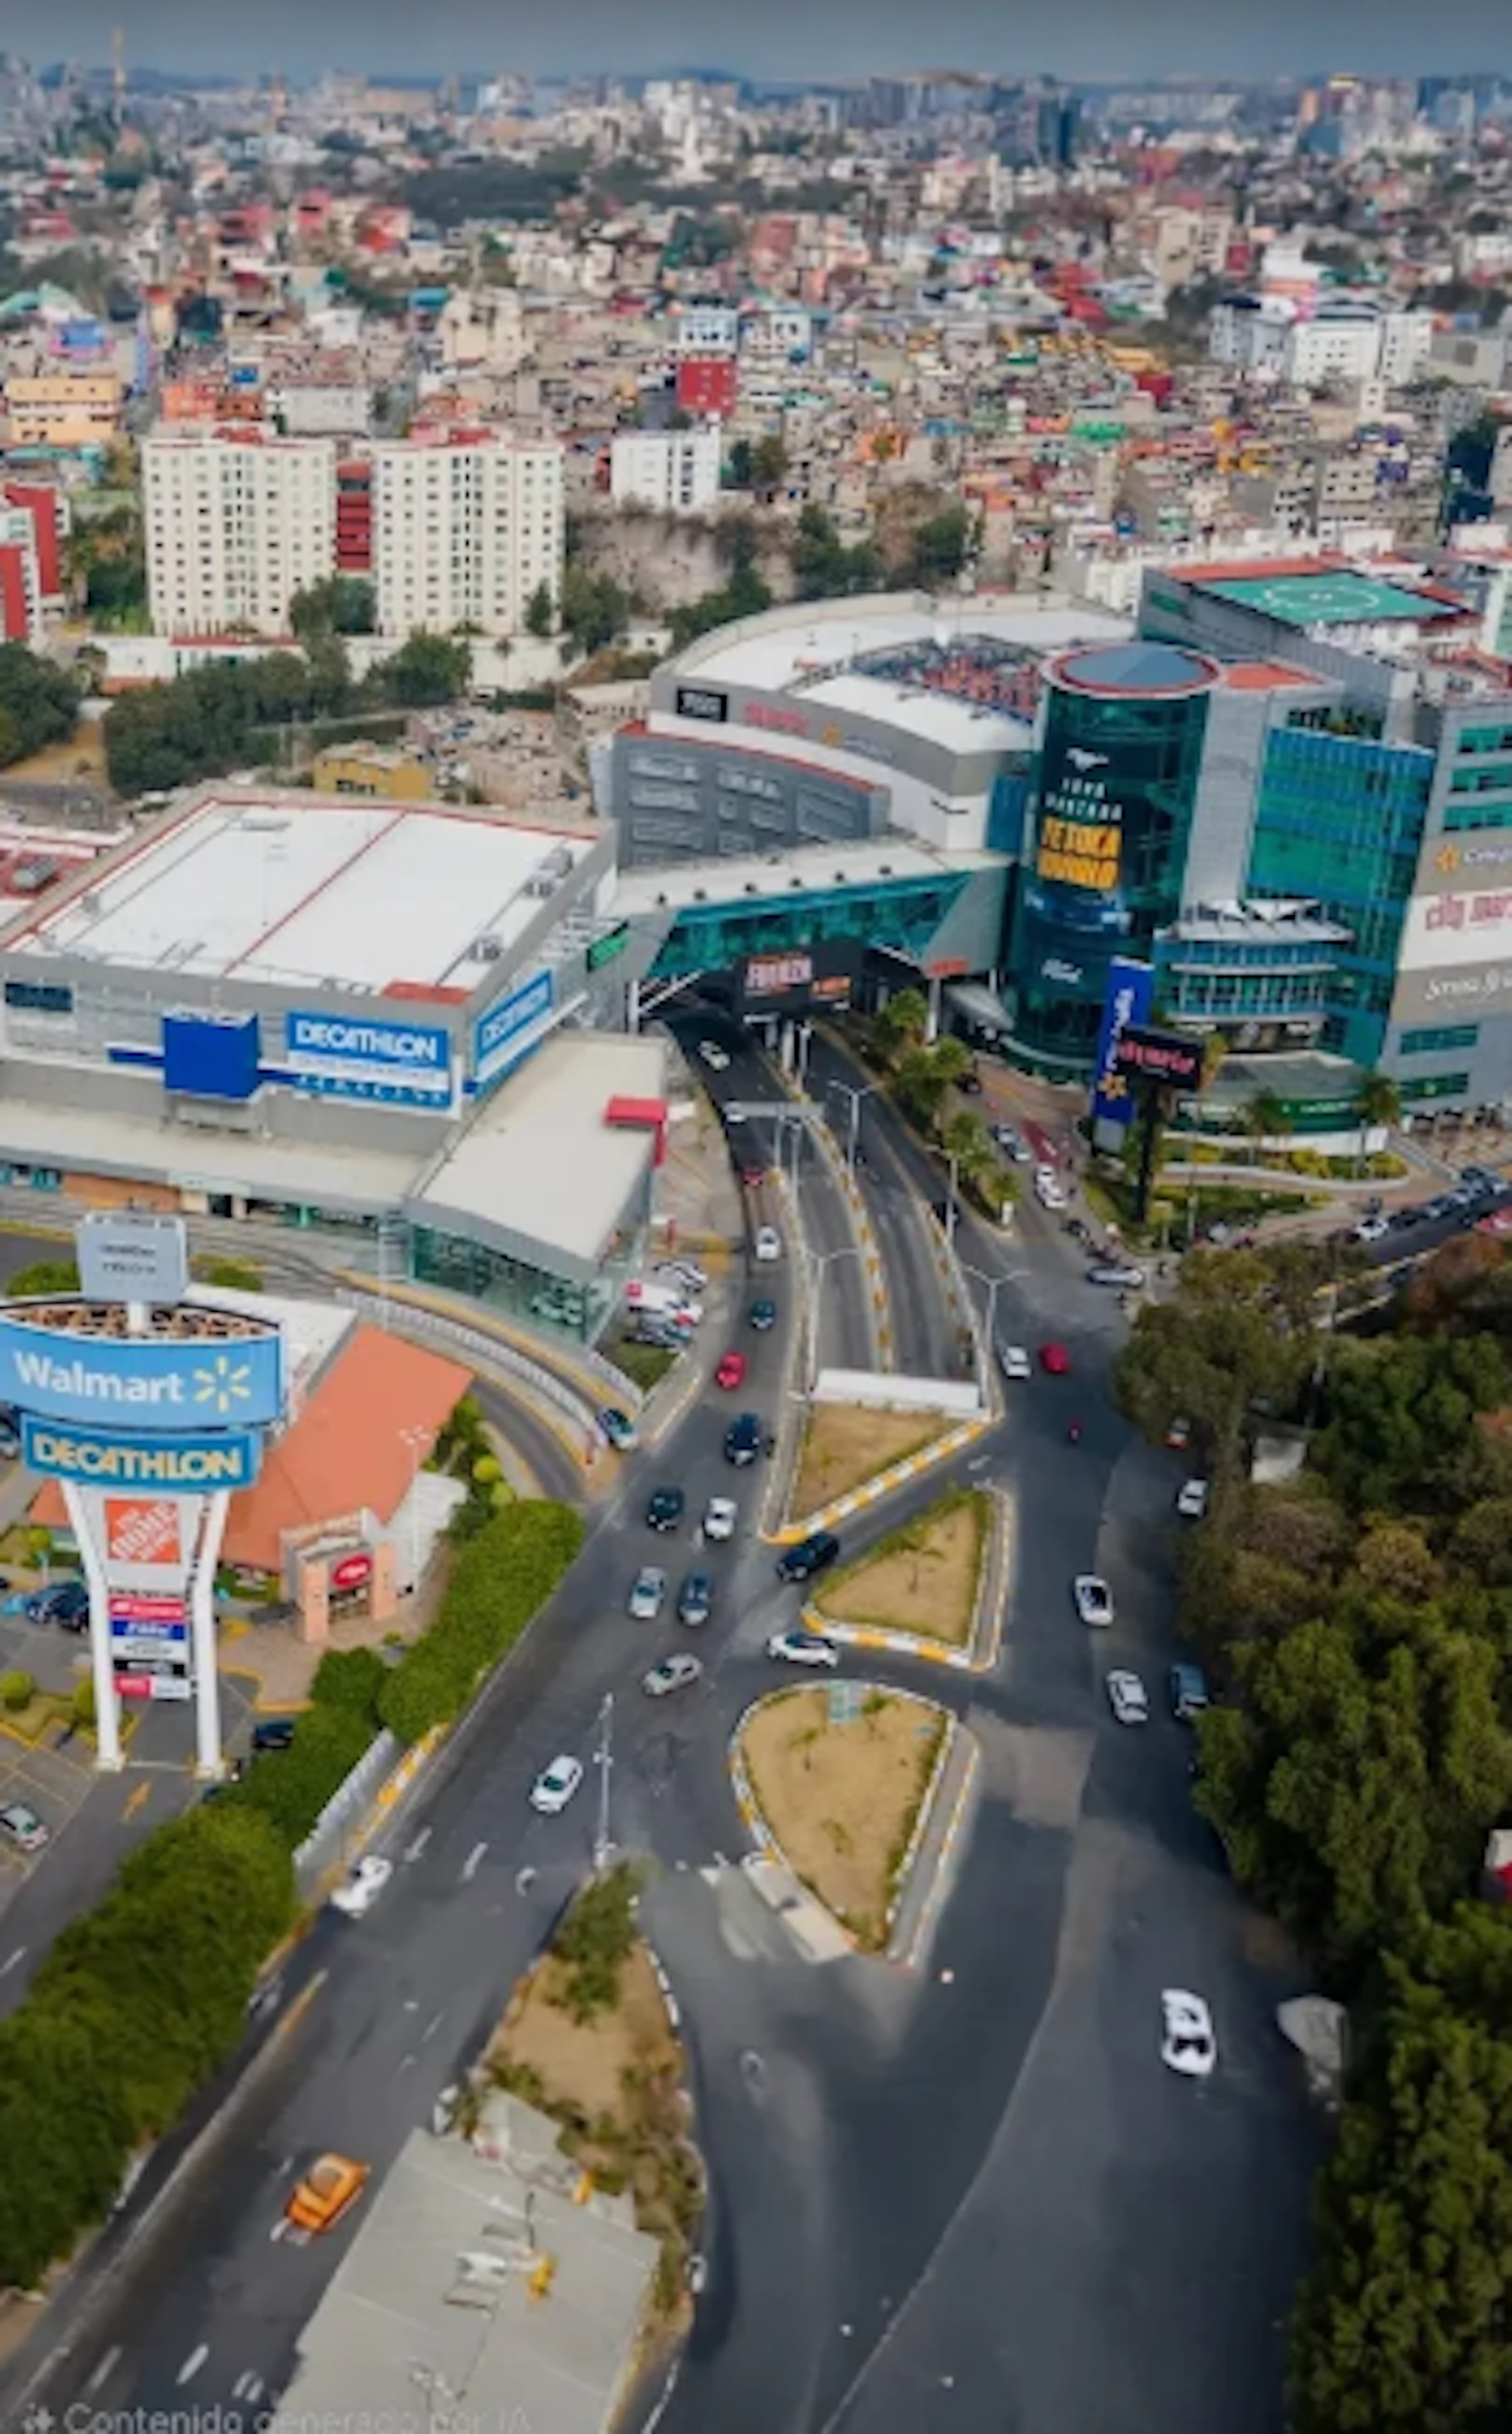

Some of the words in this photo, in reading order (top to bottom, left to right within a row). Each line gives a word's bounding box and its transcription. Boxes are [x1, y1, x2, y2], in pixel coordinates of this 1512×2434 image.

[295, 1020, 437, 1061] DECATHLON
[11, 1349, 184, 1402] Walmart
[32, 1433, 243, 1480] DECATHLON
